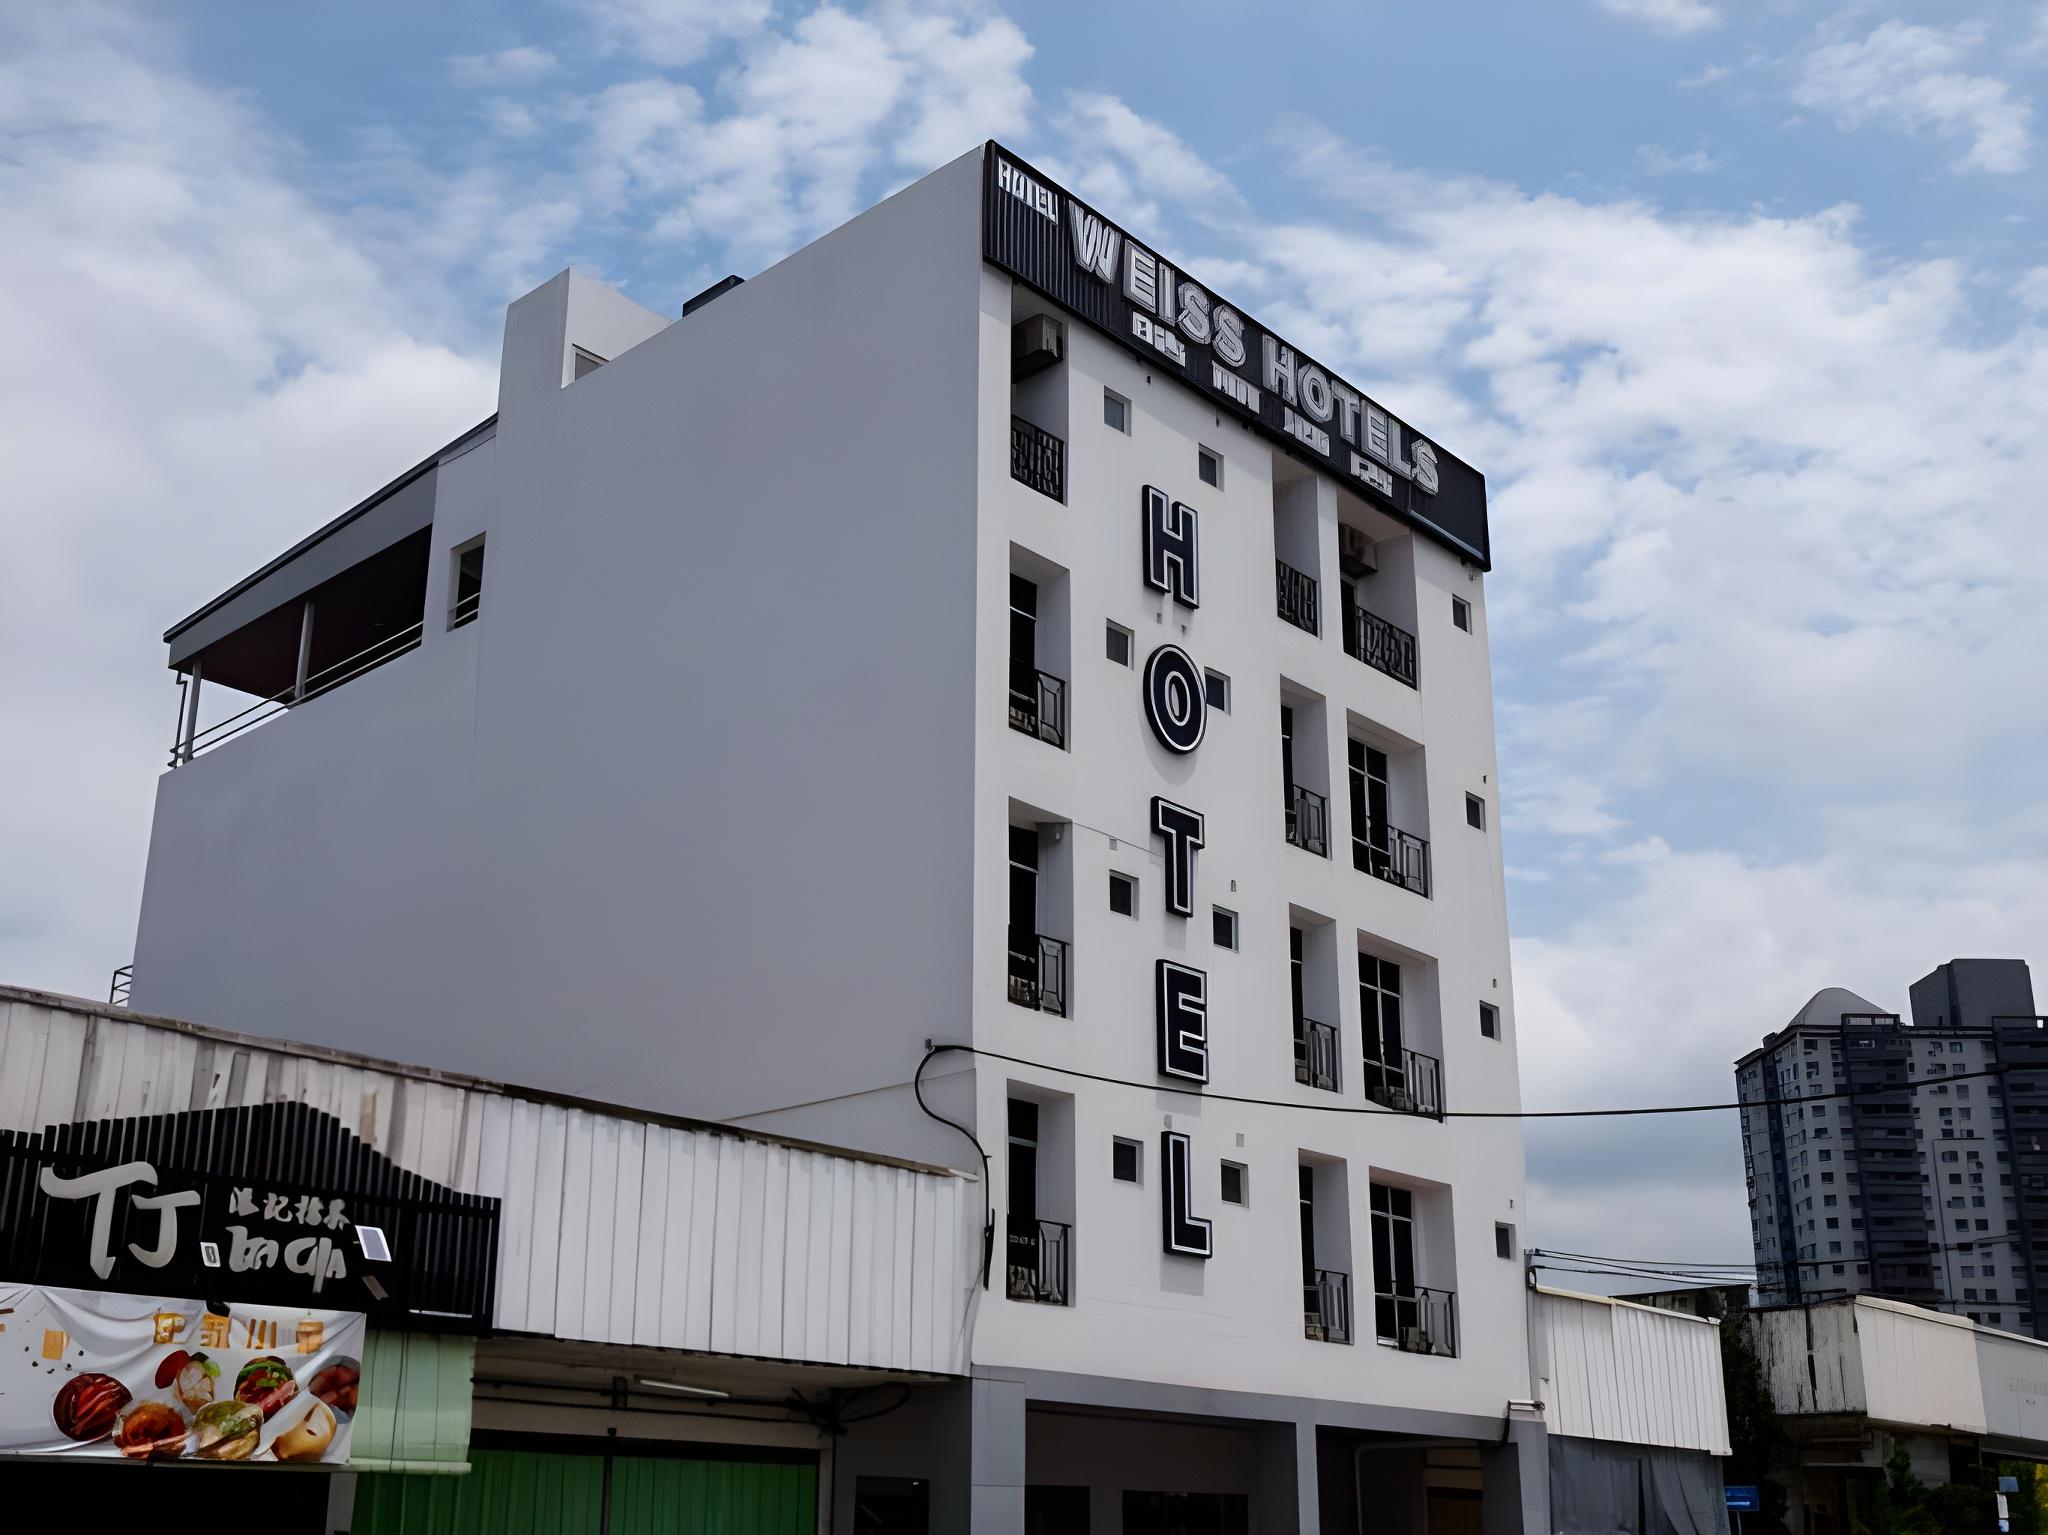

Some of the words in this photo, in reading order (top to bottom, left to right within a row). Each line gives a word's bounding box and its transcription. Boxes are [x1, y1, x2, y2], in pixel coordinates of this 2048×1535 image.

[1067, 199, 1247, 368] WEISS
[1262, 333, 1439, 496] HOTELS
[1142, 484, 1212, 1259] HOTEL
